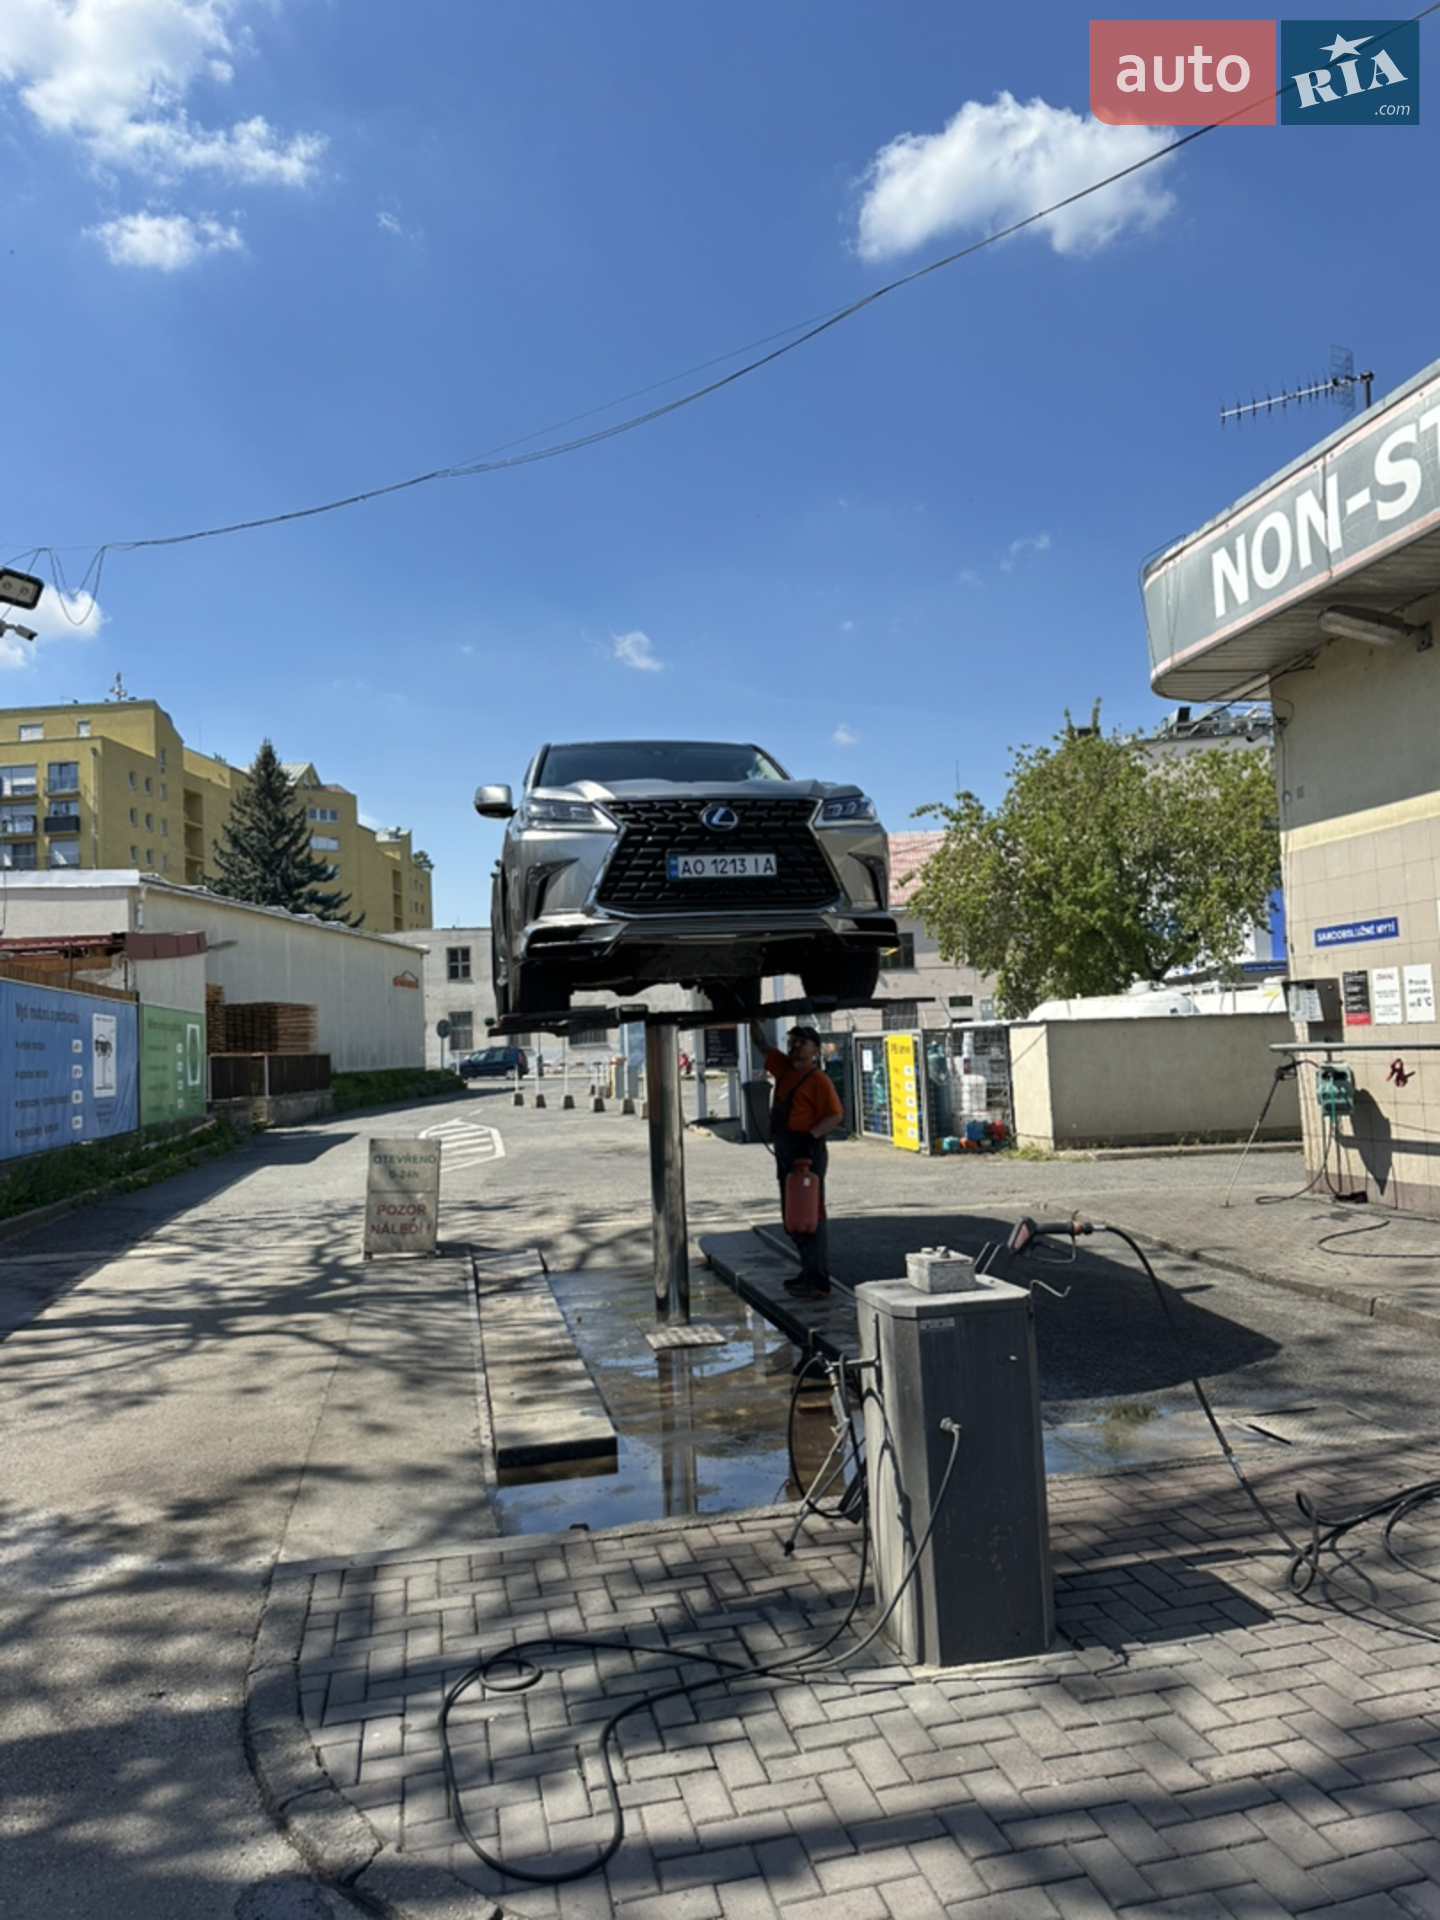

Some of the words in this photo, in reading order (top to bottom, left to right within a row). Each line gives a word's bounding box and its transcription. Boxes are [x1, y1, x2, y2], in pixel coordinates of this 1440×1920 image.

[681, 859, 705, 875] AO
[711, 858, 747, 875] 1213
[754, 857, 774, 873] IA
[373, 1153, 436, 1164] OTEVŘENO
[376, 1204, 426, 1216] POZOR
